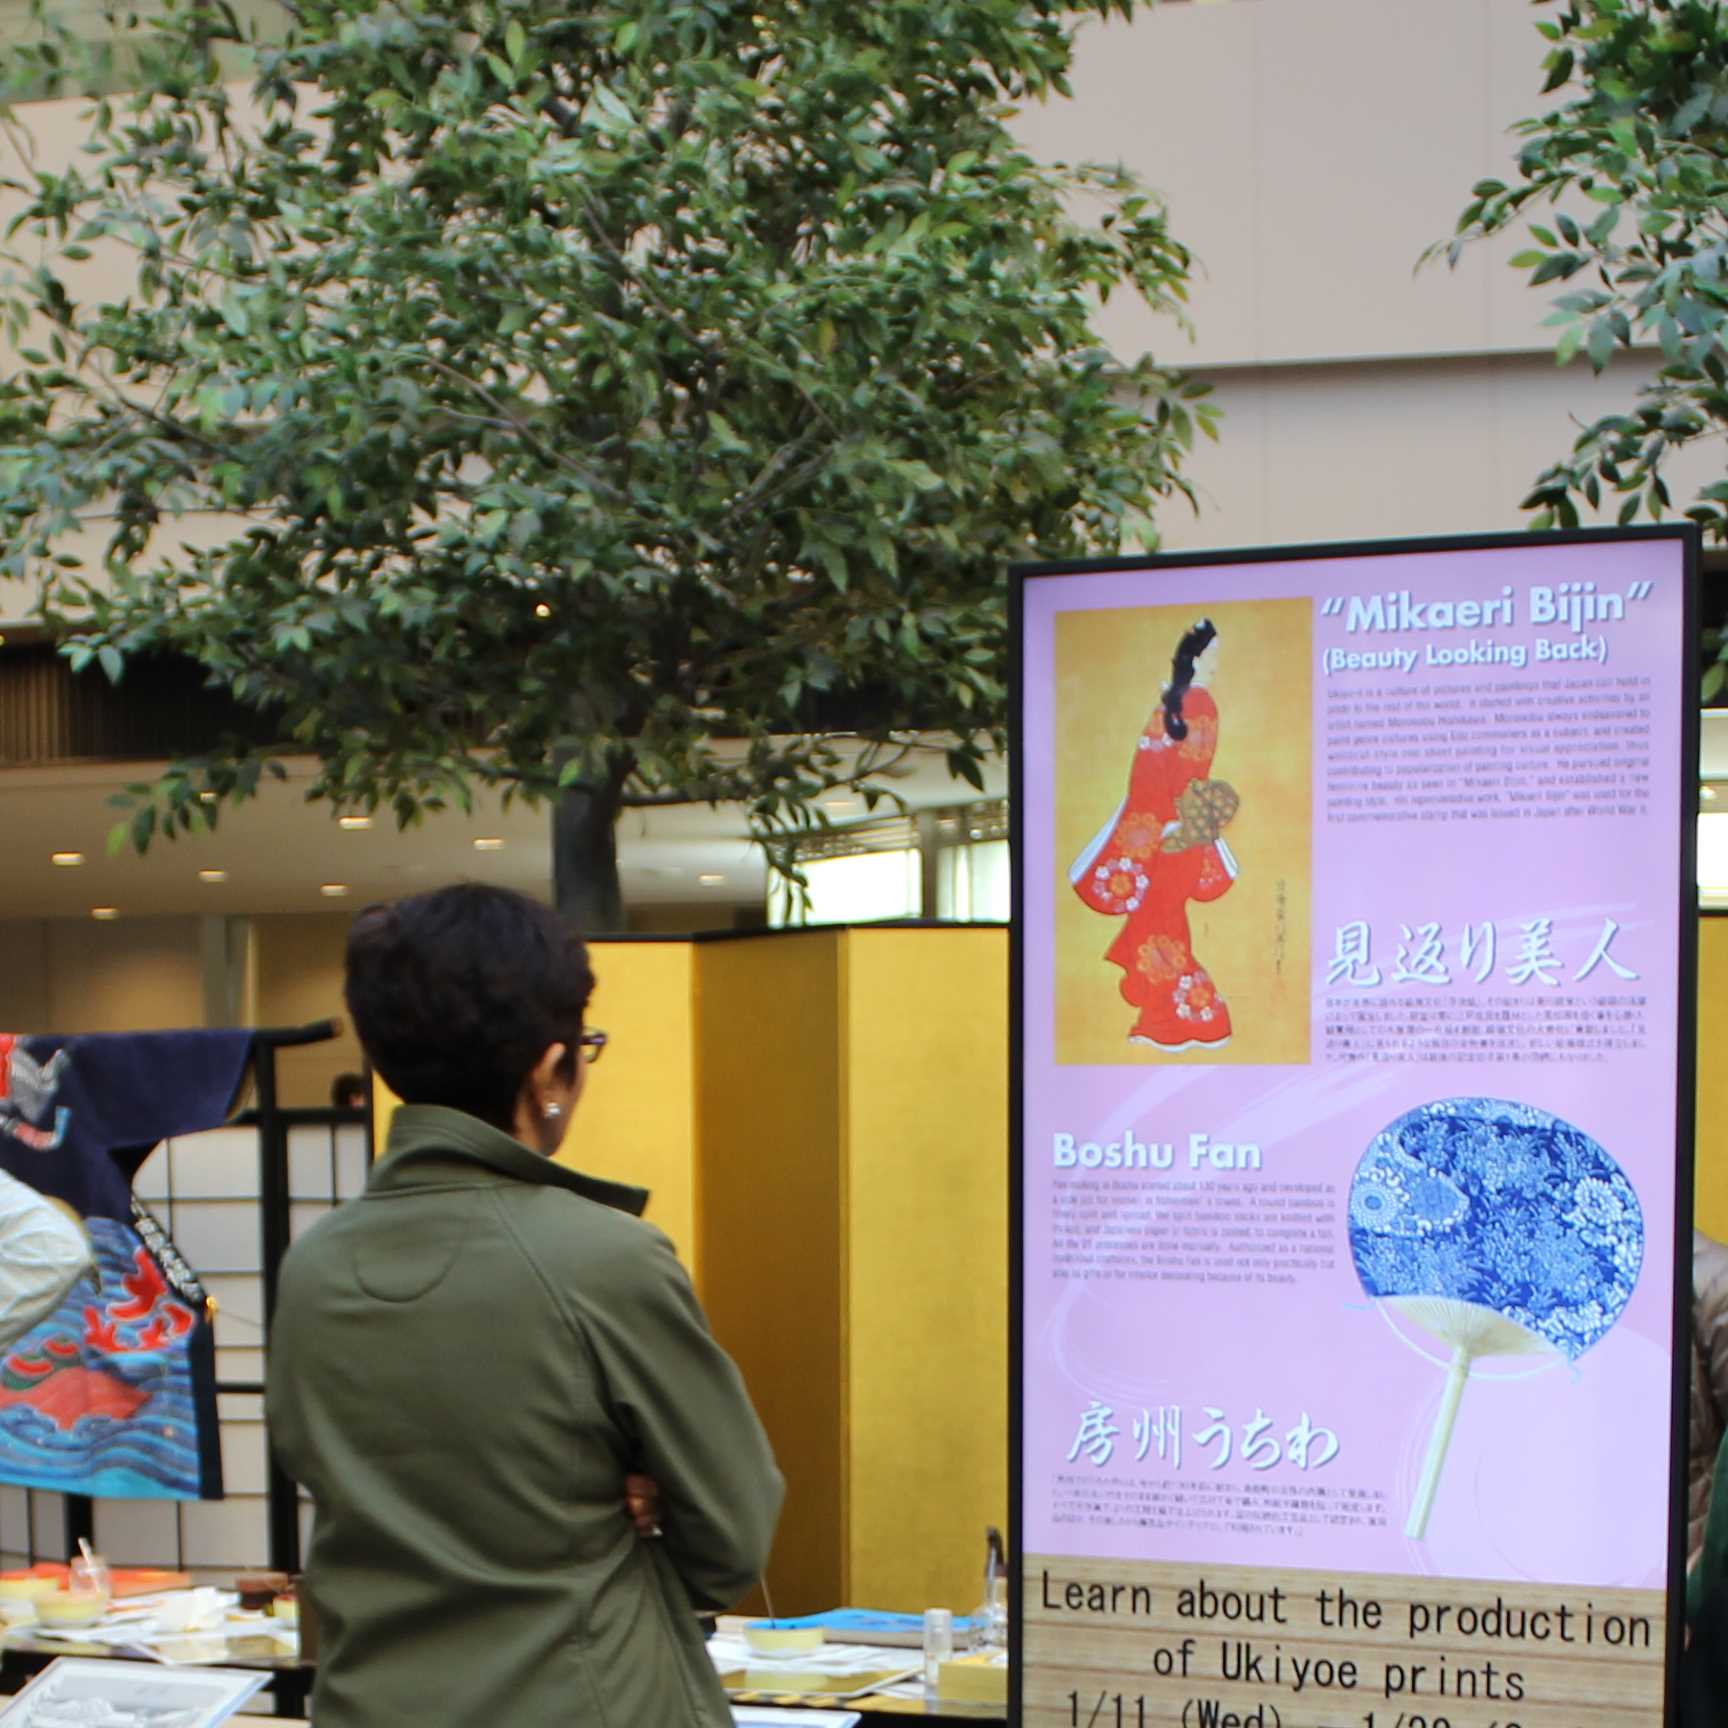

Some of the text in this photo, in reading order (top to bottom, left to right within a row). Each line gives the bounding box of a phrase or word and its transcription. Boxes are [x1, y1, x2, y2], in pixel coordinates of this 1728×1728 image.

[1322, 635, 1608, 676] (Beauty Looking Back)
[1325, 917, 1641, 987] 見返り美人
[1053, 1130, 1262, 1169] Boshu Fan
[1065, 1400, 1341, 1471] 房州うちわ
[1042, 1570, 1651, 1648] Learn about the production
[1153, 1639, 1526, 1701] of Ukiyoe prints
